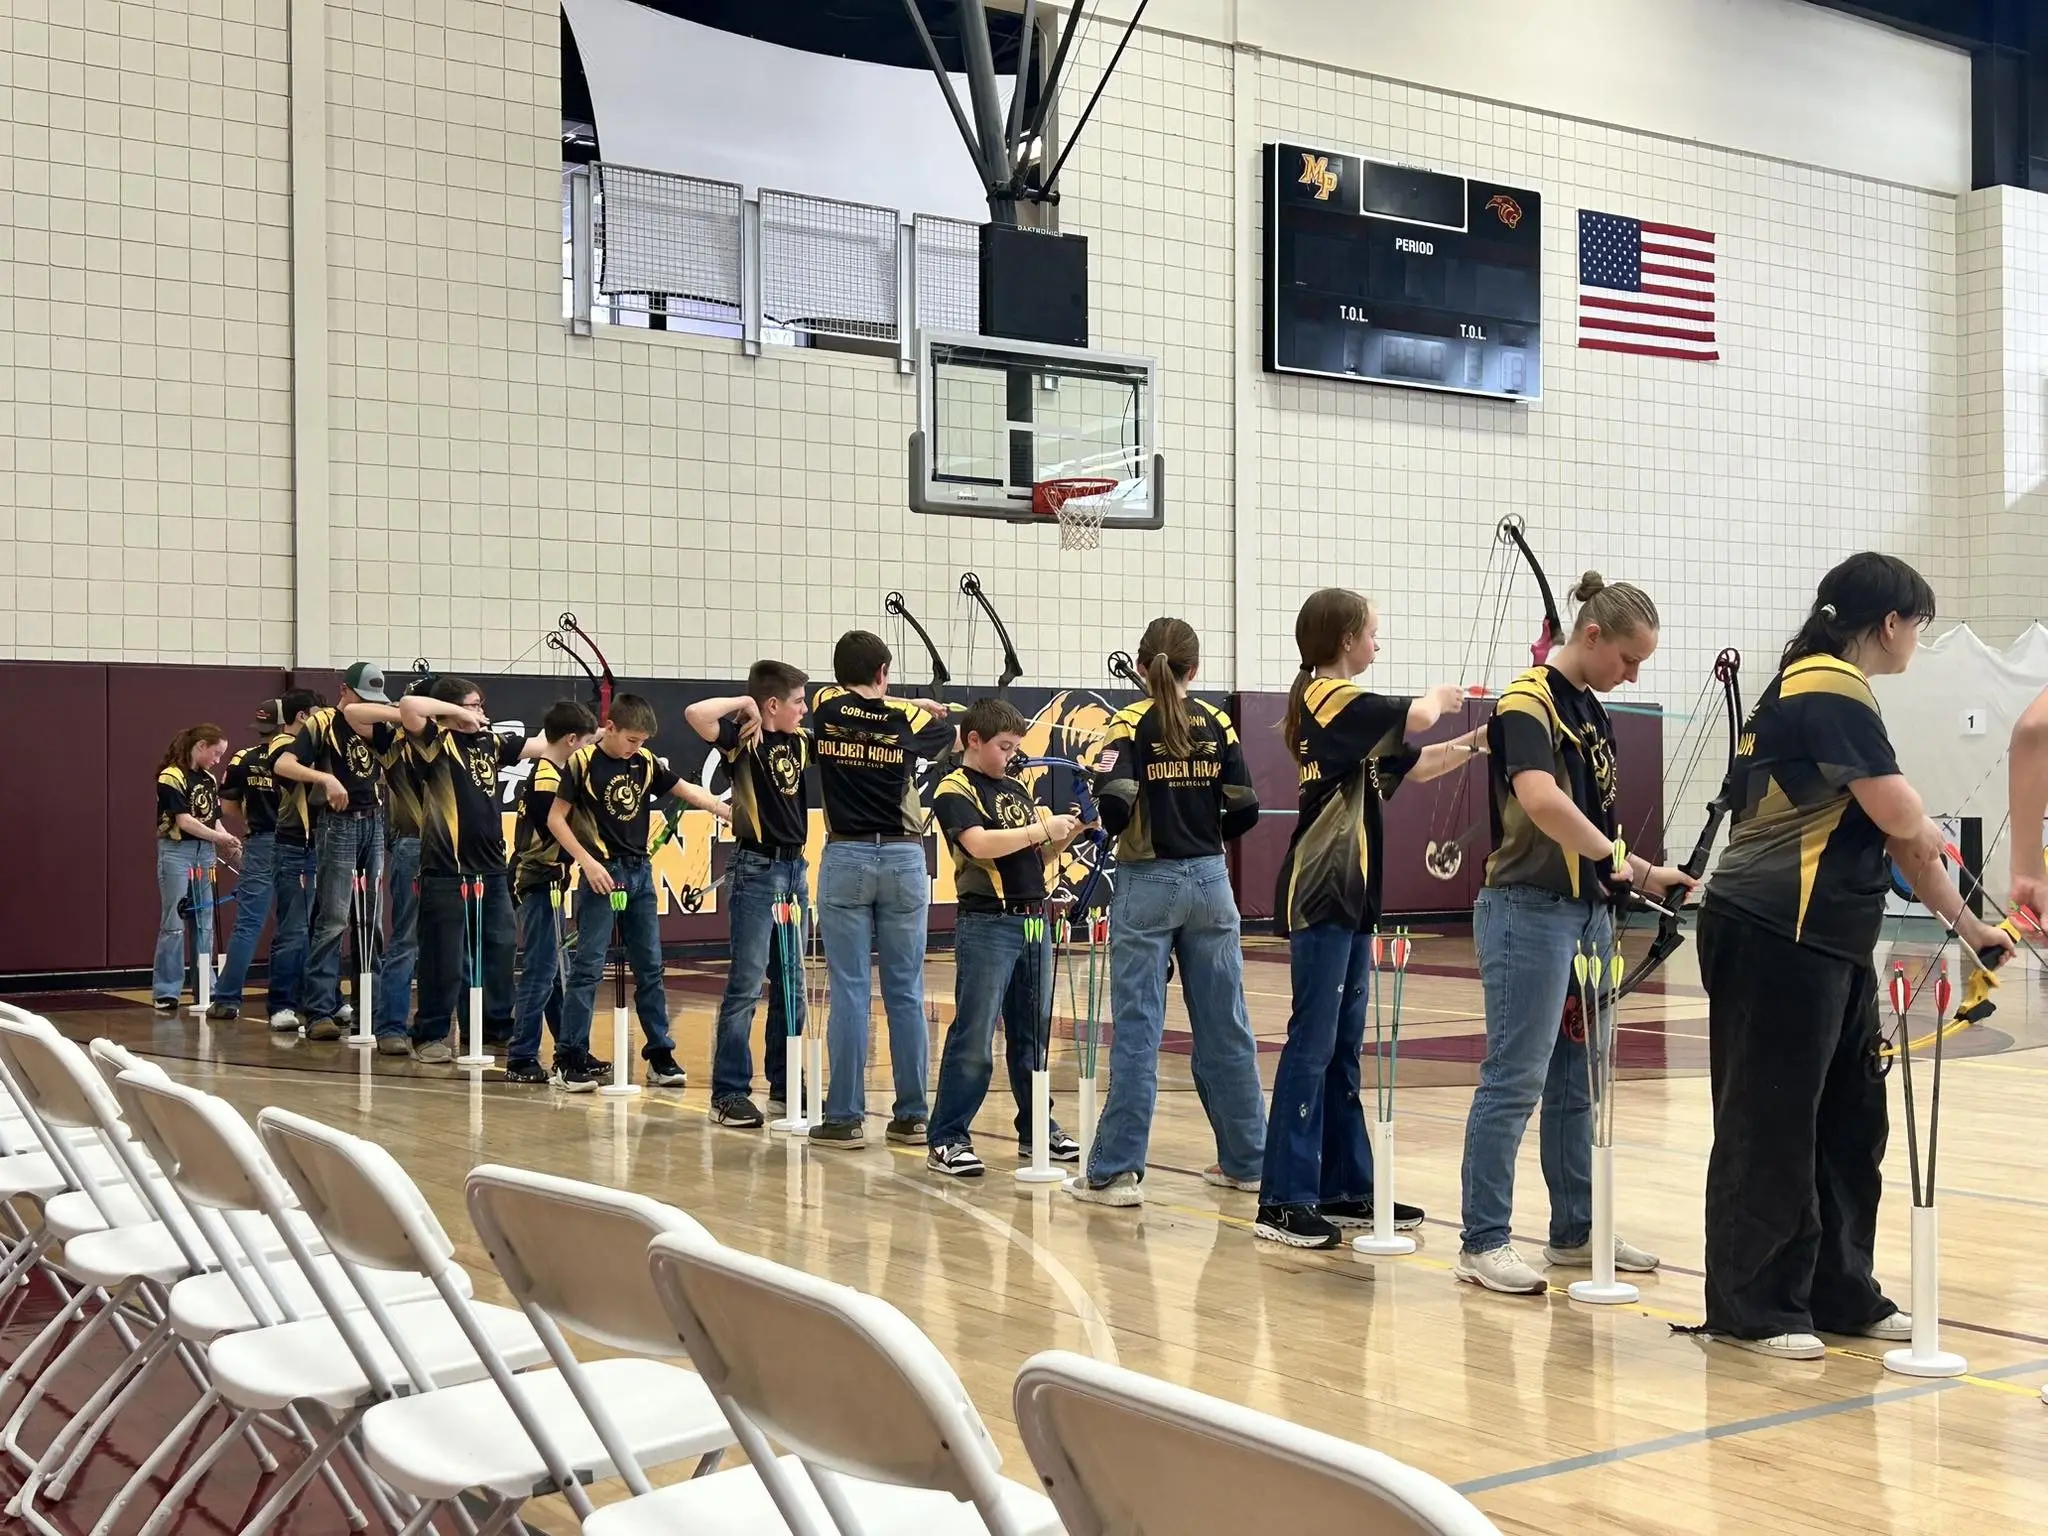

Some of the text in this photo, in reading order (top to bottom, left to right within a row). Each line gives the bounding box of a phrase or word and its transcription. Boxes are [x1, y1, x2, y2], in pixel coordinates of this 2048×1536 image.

[1298, 153, 1338, 200] MP
[1395, 237, 1434, 255] PERIOD
[1340, 305, 1369, 322] T.O.L.
[1459, 324, 1487, 340] T.O.L.
[1967, 715, 1974, 728] 1
[817, 740, 904, 764] GOLDEN HAWK
[1147, 760, 1221, 780] GOLDEN HAWK
